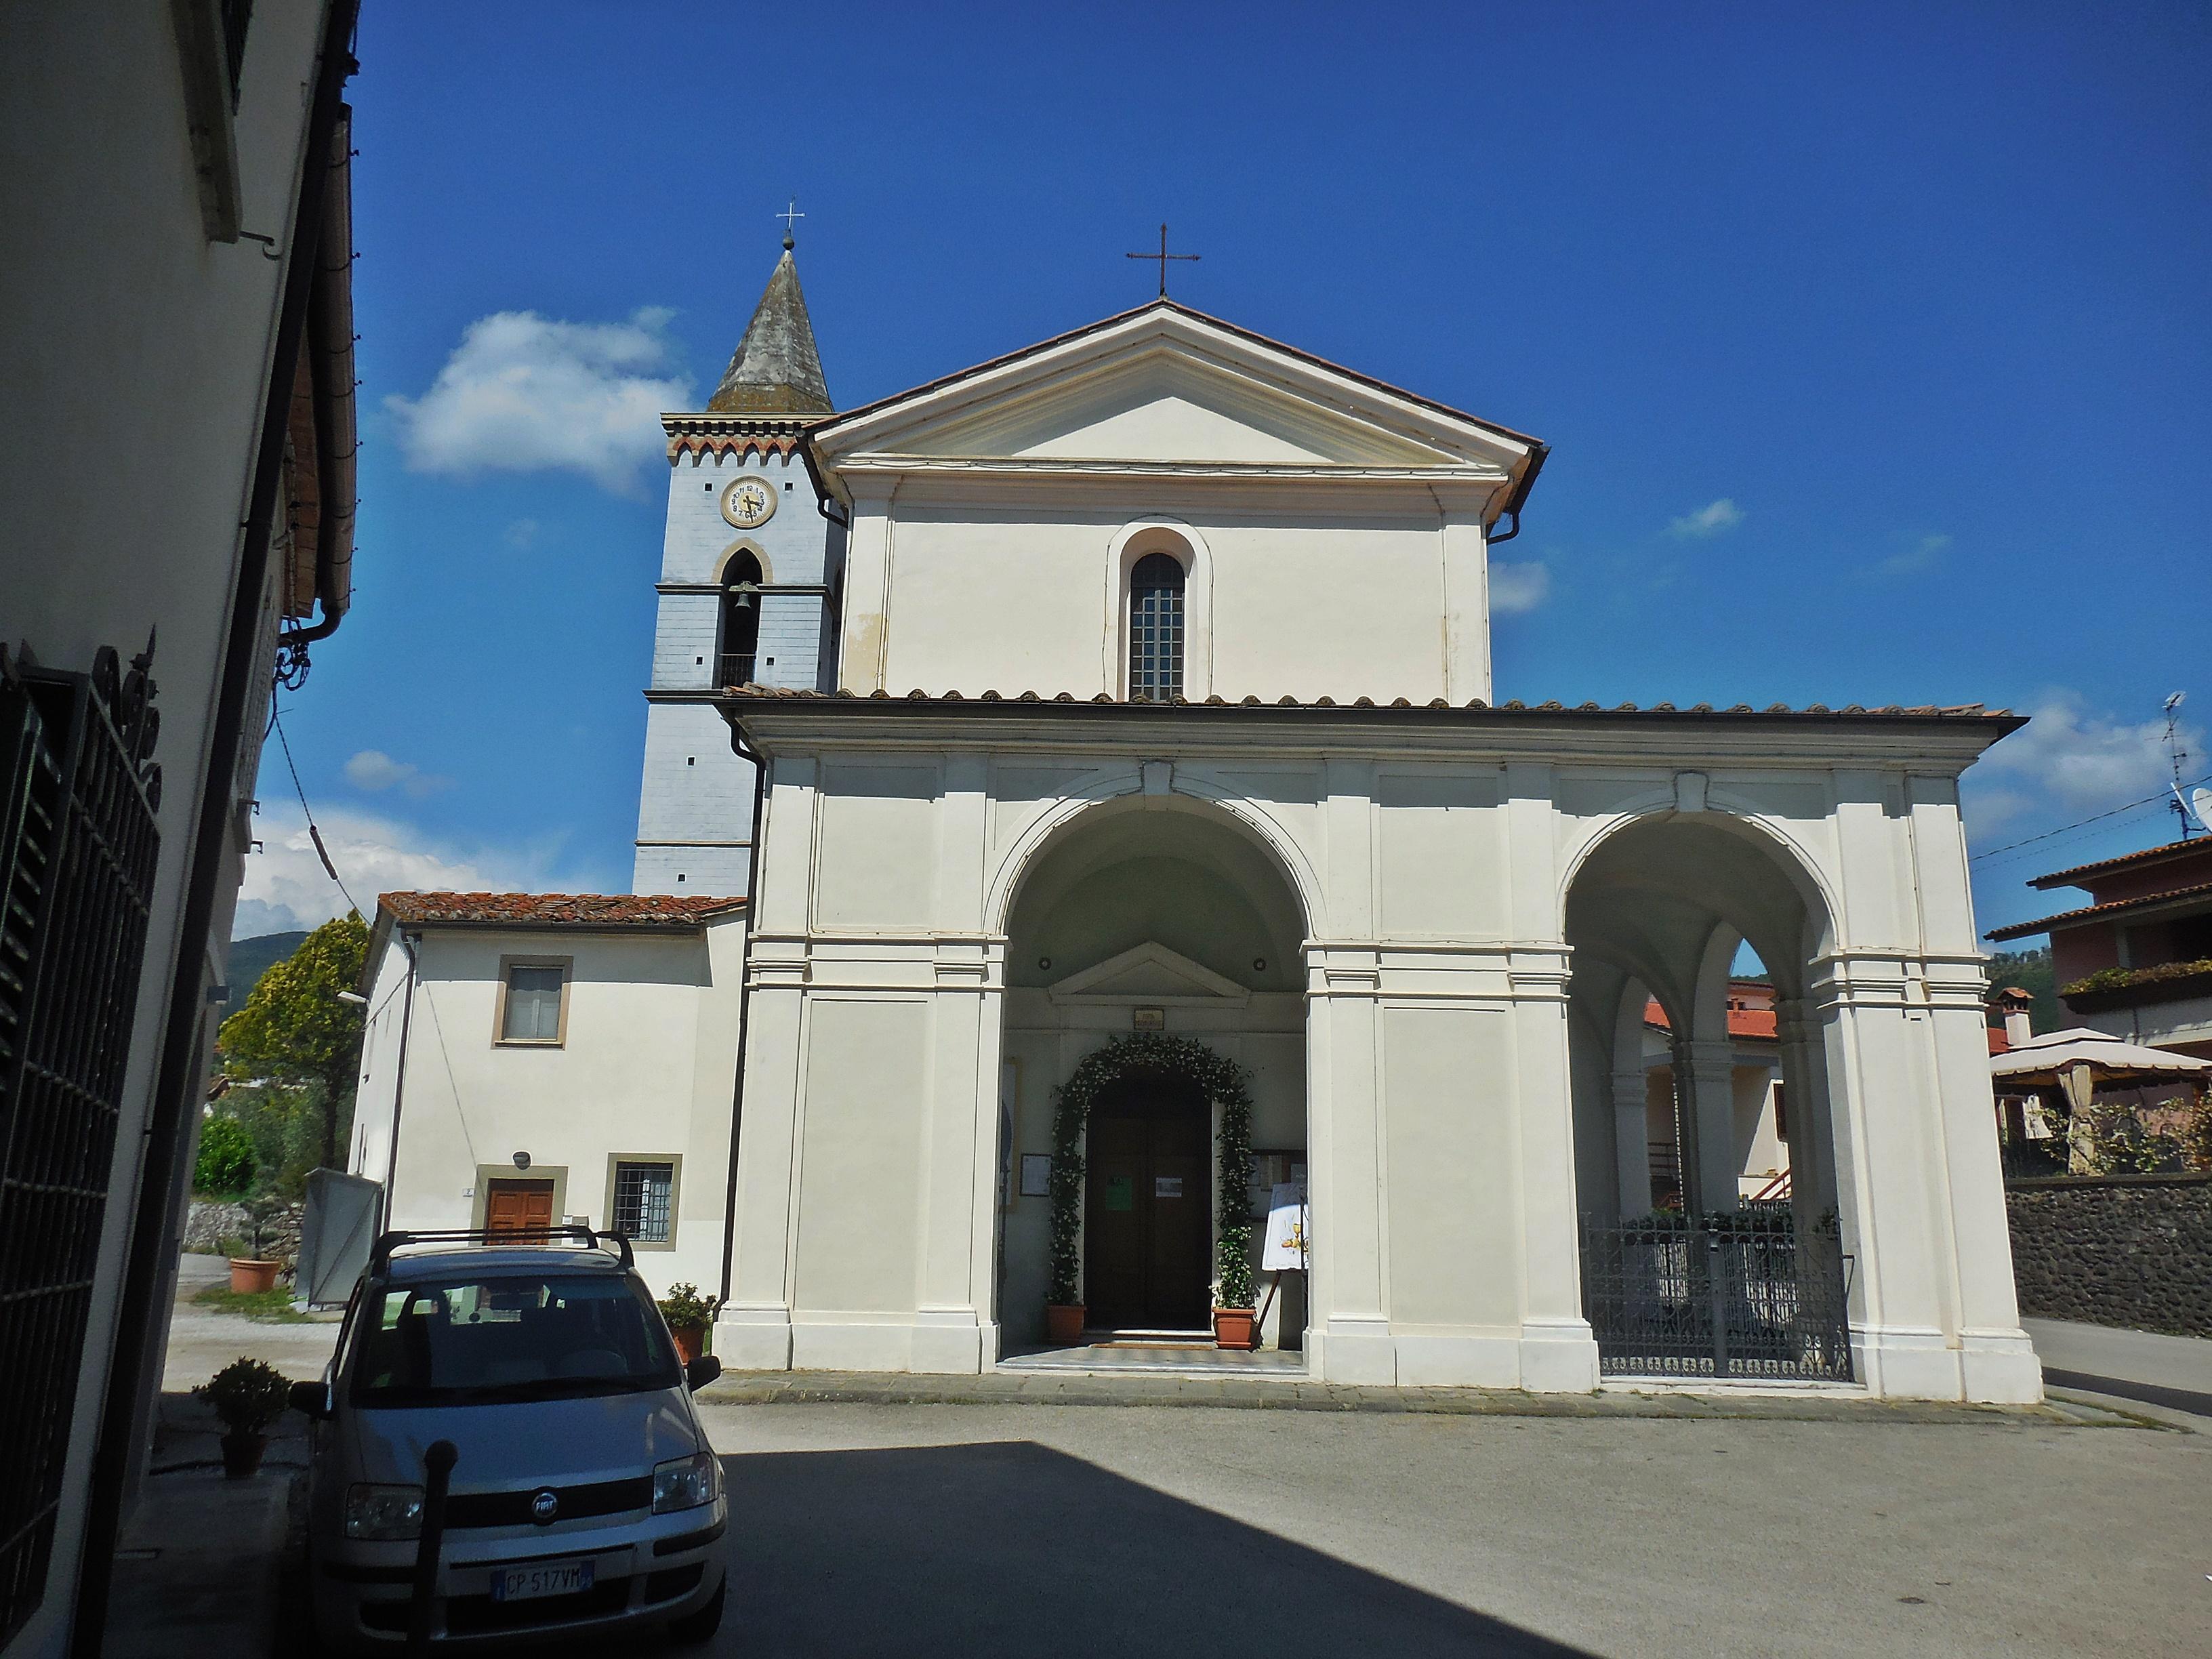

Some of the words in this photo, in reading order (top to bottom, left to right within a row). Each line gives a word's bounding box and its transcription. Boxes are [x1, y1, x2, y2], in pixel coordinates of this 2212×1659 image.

[536, 1501, 554, 1511] FIAT
[507, 1574, 526, 1595] CP
[531, 1568, 580, 1592] 517VM
